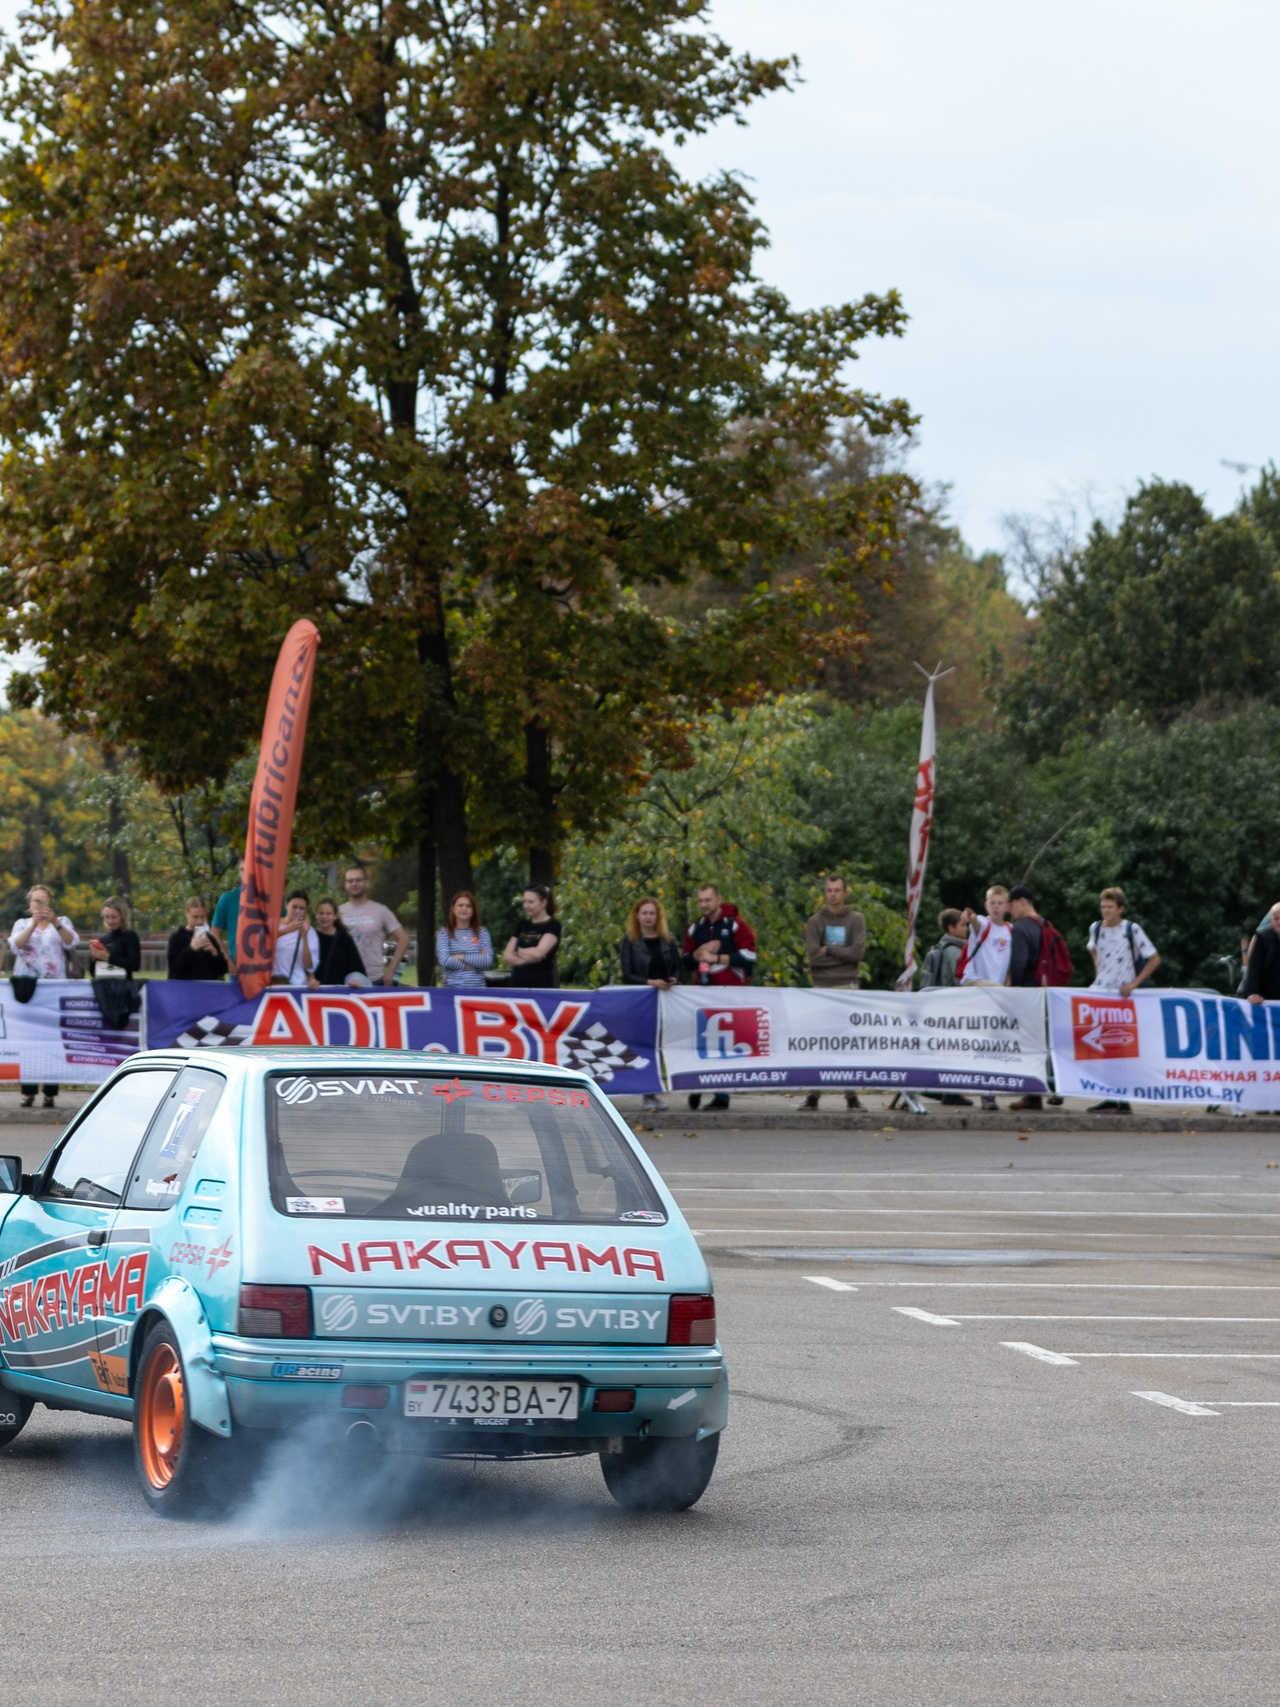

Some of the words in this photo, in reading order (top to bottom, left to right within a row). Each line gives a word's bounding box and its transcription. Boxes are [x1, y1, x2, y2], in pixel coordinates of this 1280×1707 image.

[65, 1000, 98, 1008] НОМЕРА-
[849, 1012, 902, 1026] ФЛАГИ
[923, 1015, 1020, 1029] ФЛАГШТОКИ
[1078, 1003, 1133, 1028] Pyrmo
[788, 1036, 920, 1050] КОРПОРАТИВНАЯ
[927, 1037, 1021, 1053] СИМВОЛИКА
[699, 1071, 787, 1084] WWW.FLAG.BY
[819, 1071, 907, 1081] WWW.FLAG.BY
[938, 1073, 1024, 1087] WWW.FLAG.BY
[1165, 1069, 1257, 1082] НАДЕЖНАЯ
[483, 1083, 590, 1108] CEPSA
[406, 1203, 480, 1218] Quality
[485, 1205, 538, 1219] parts
[306, 1239, 666, 1283] NAKAYAMA
[367, 1304, 485, 1327] SVT.BY
[555, 1308, 662, 1330] SVT.BY
[408, 1401, 423, 1412] BY
[432, 1384, 495, 1414] 7433
[503, 1386, 572, 1415] BA-7
[473, 1418, 510, 1426] PEUGEOT
